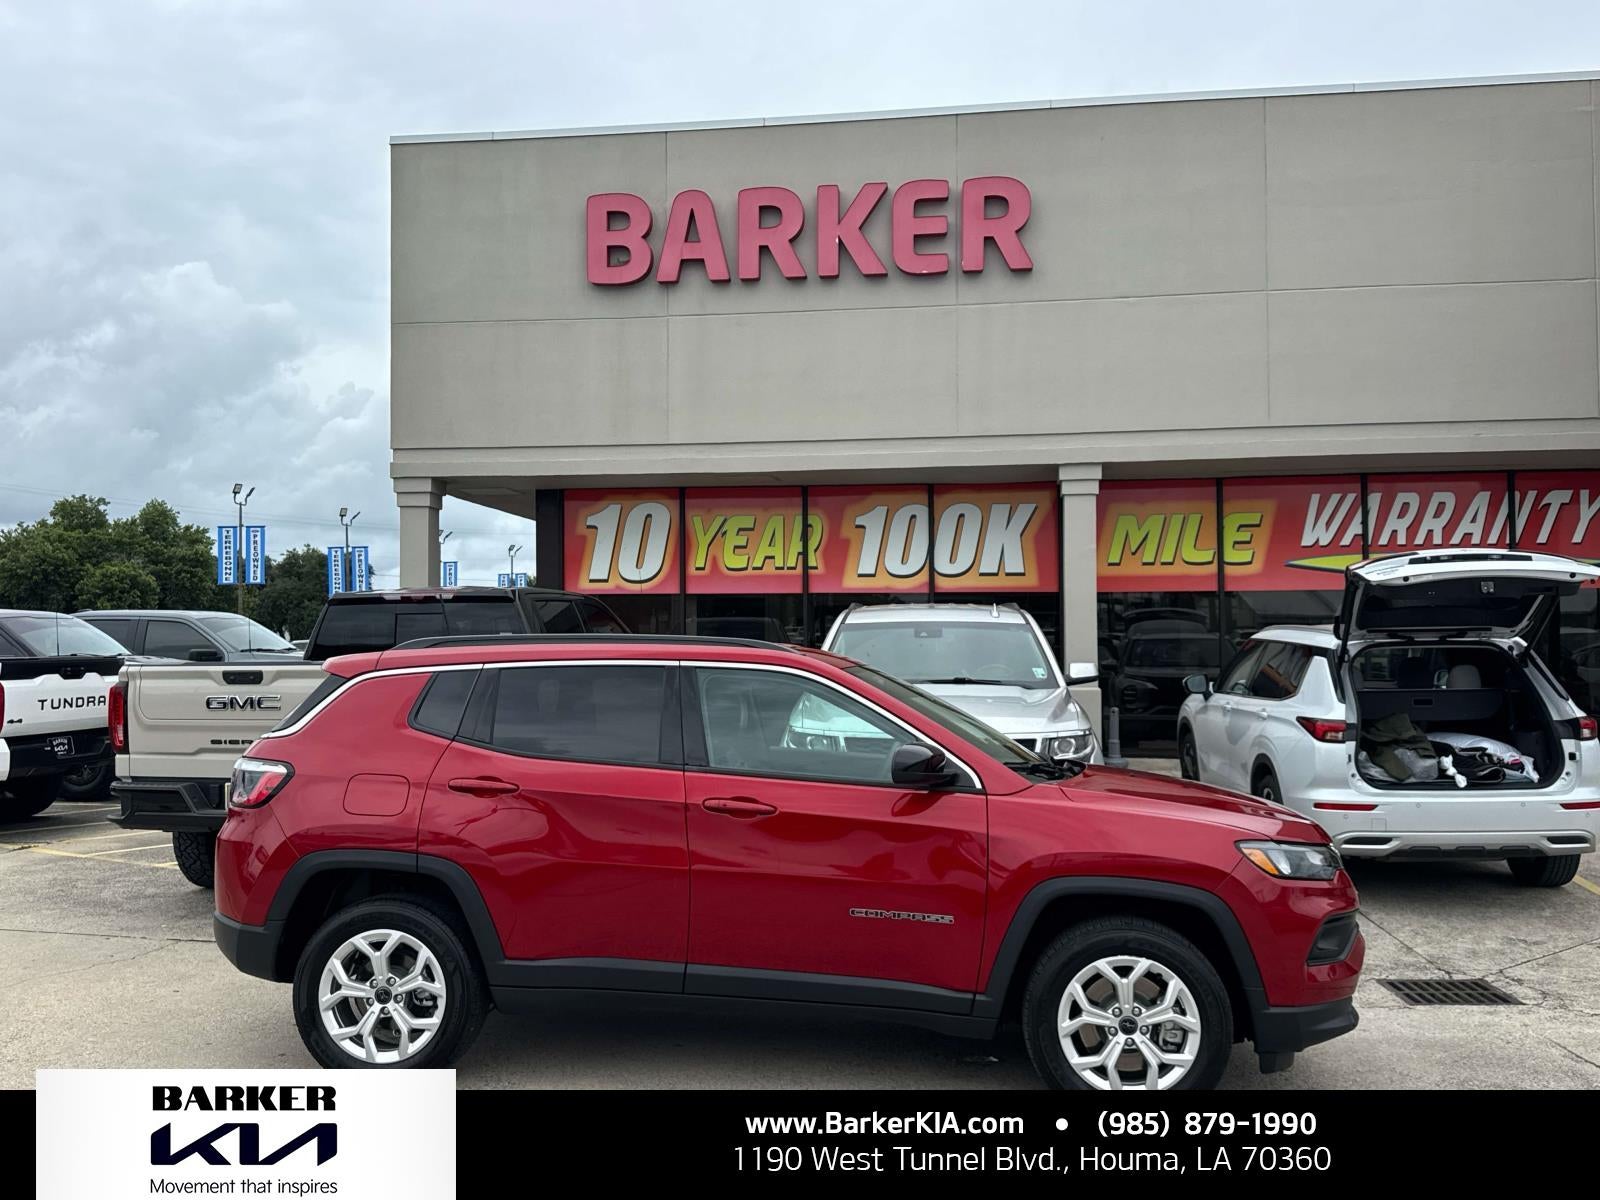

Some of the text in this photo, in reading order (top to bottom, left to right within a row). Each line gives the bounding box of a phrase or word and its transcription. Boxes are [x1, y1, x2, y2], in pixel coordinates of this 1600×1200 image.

[586, 176, 1033, 287] BARKER
[224, 529, 232, 581] TERREBONNE
[585, 489, 1600, 584] 10 YEAR 100K MILE WARRANTY
[333, 550, 341, 592] TERREBONN
[37, 695, 107, 711] TUNDRA
[205, 694, 282, 711] GMC
[849, 907, 955, 924] COMPASS
